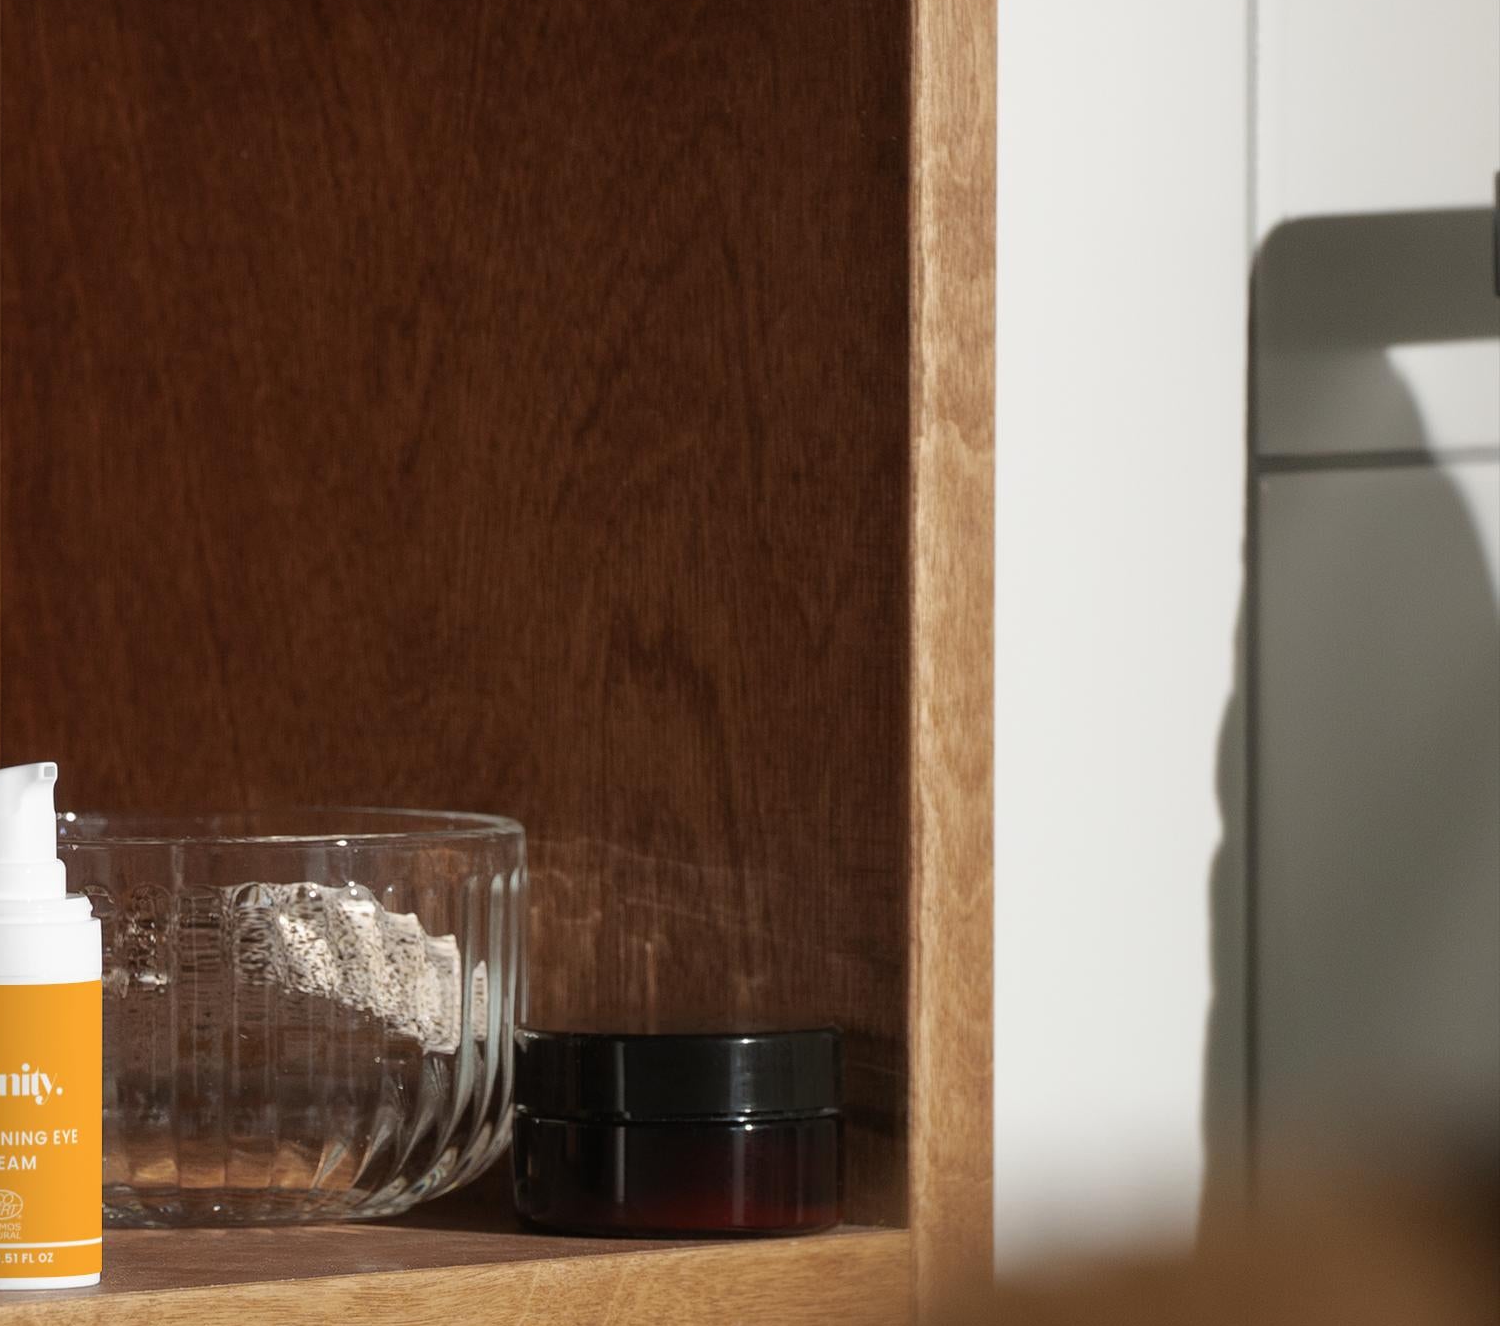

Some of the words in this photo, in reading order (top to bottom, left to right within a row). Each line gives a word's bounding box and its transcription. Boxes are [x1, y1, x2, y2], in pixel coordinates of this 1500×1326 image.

[53, 1128, 78, 1145] EYE
[21, 1252, 35, 1264] FL
[37, 1251, 54, 1263] OZ
